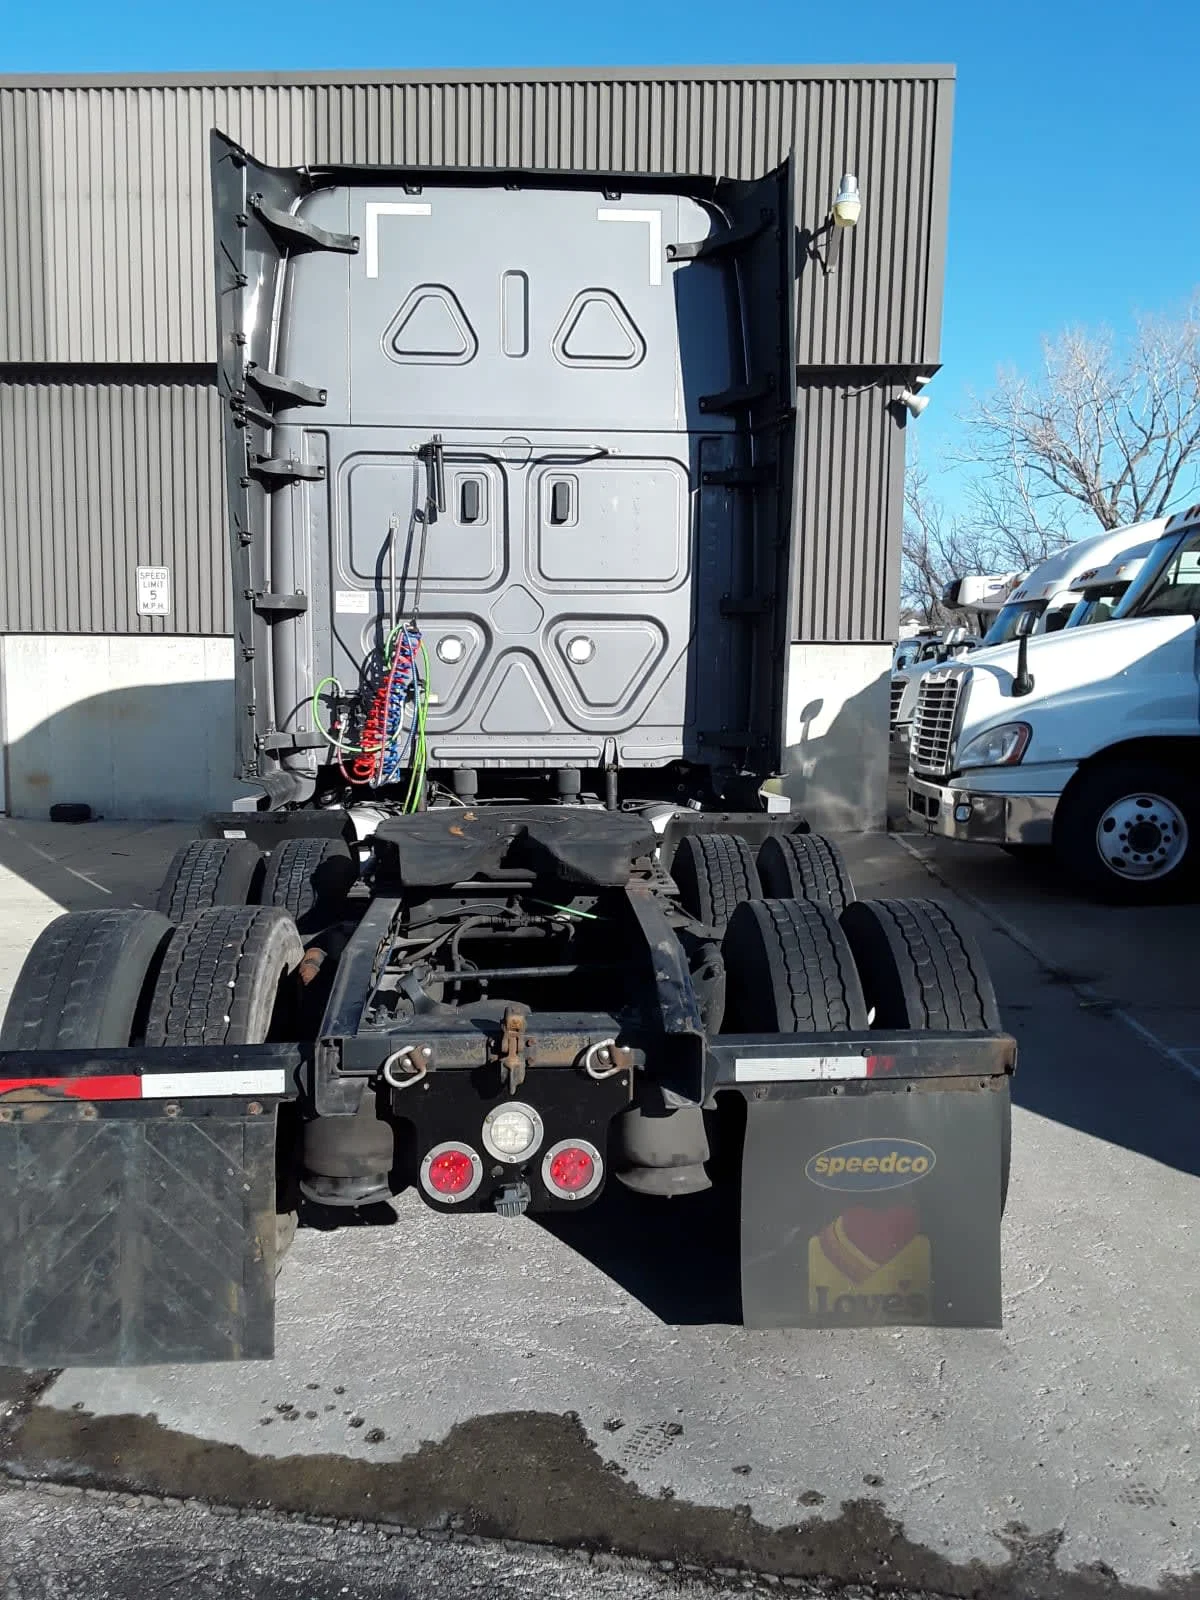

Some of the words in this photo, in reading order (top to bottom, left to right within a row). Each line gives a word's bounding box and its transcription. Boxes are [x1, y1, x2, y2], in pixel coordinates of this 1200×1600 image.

[140, 572, 166, 580] SPEED
[143, 580, 163, 588] LIMIT
[150, 590, 157, 600] 5
[815, 1152, 929, 1177] speedco
